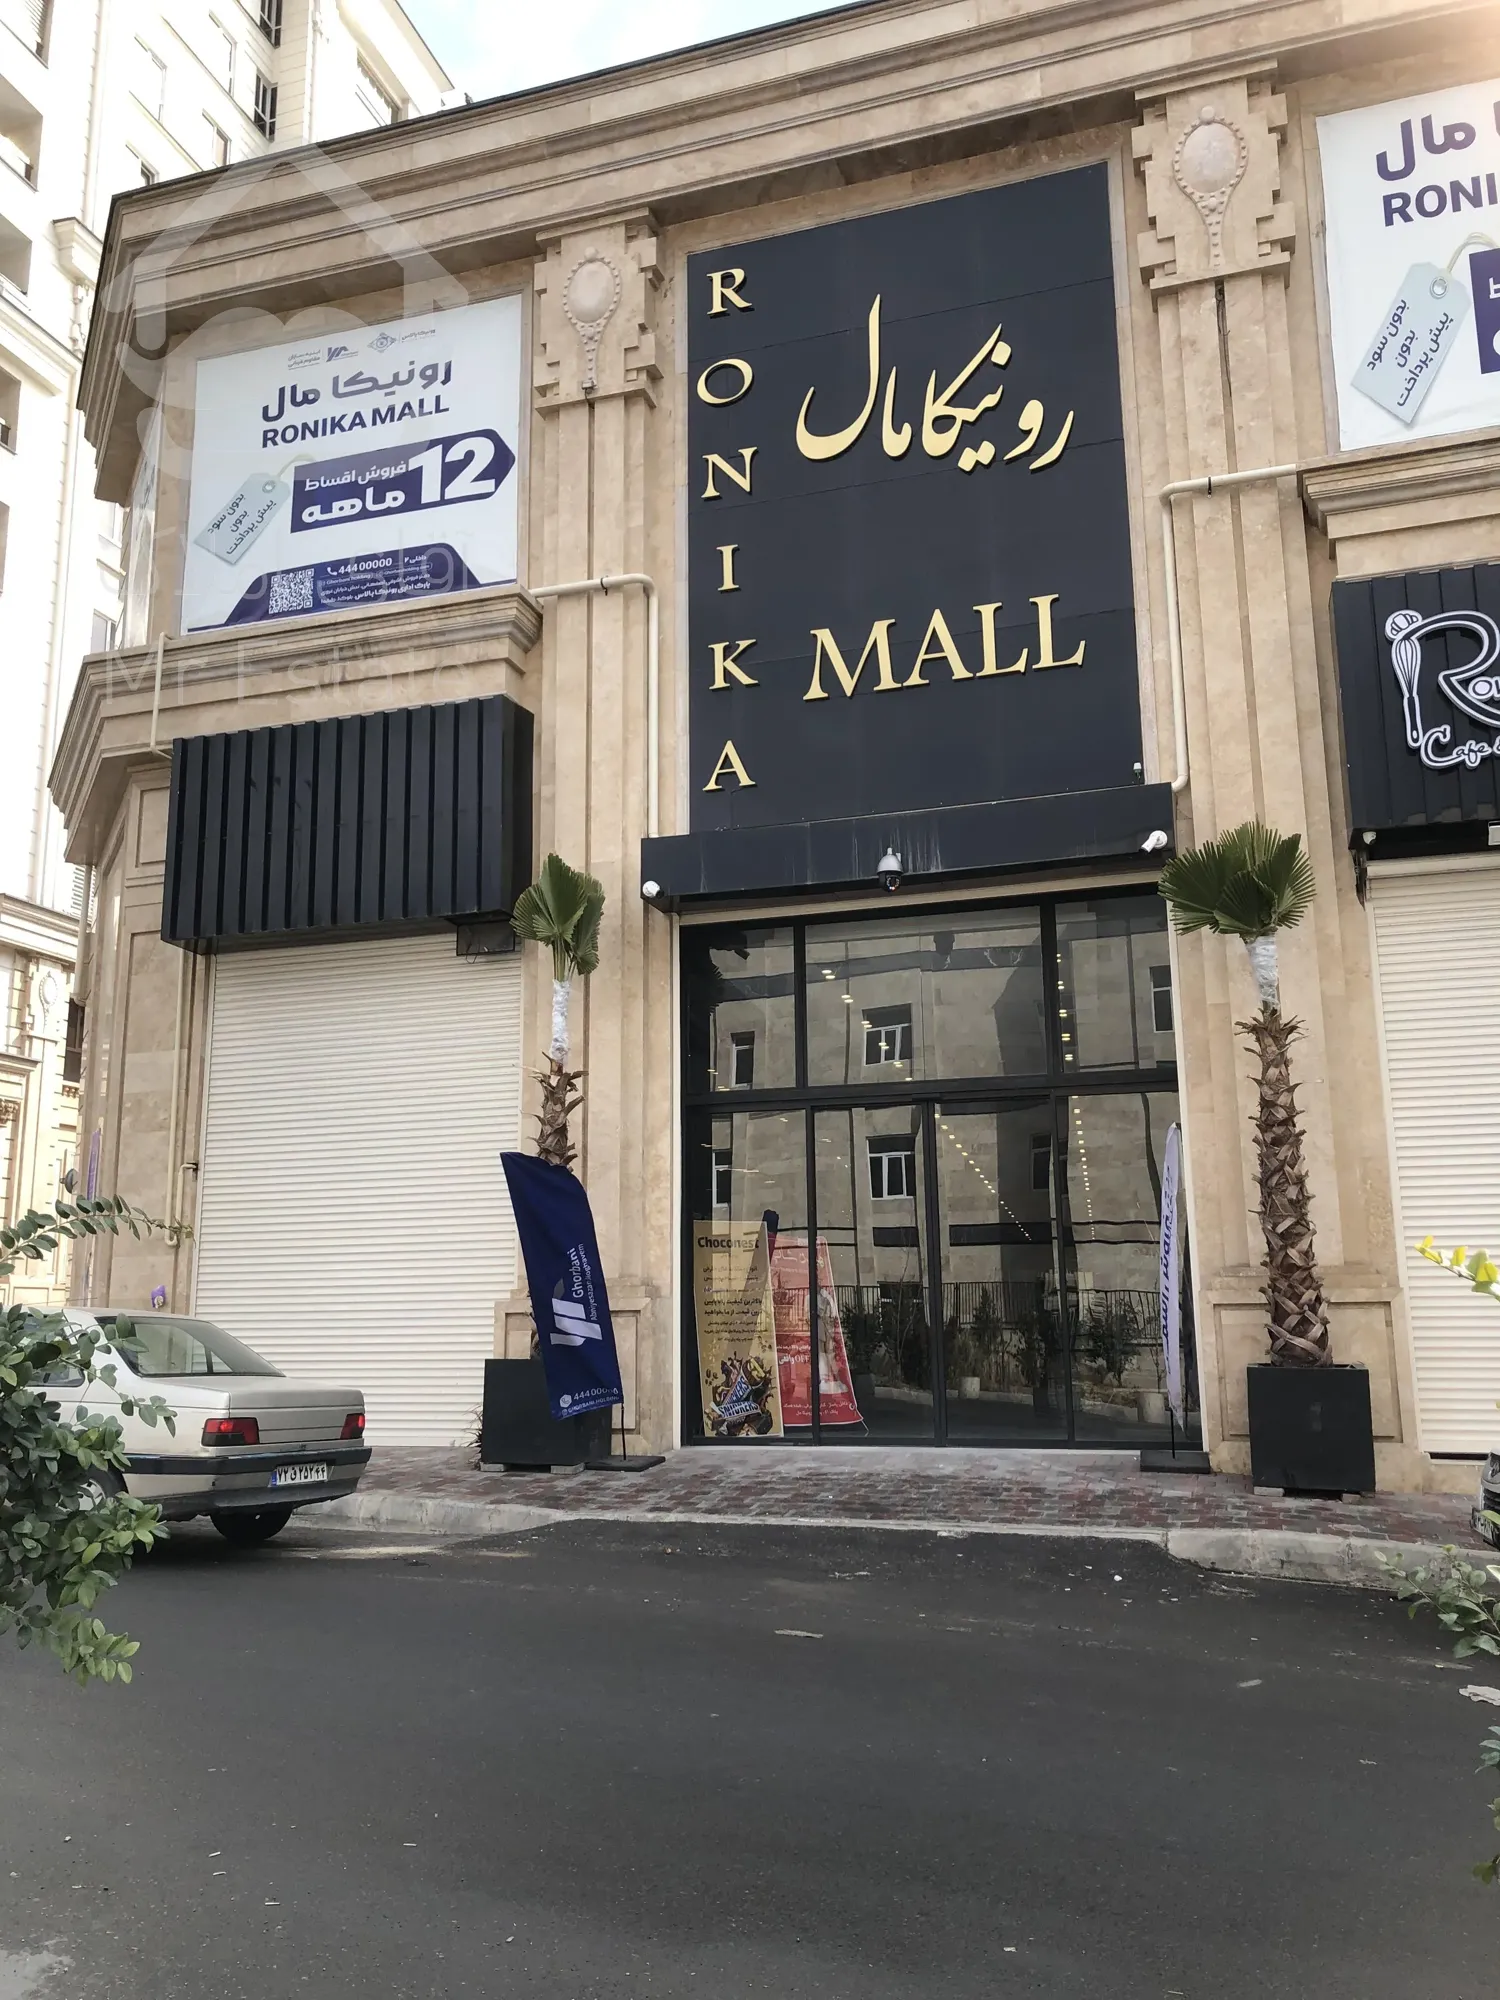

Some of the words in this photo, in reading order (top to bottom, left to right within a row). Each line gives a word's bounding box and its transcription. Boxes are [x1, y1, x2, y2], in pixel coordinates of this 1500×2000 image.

[1376, 114, 1476, 182] مال
[1387, 299, 1410, 338] بدون
[1429, 311, 1454, 354] پیش
[1366, 335, 1388, 371] سود
[1395, 329, 1417, 368] بدون
[332, 360, 452, 399] رونیکا
[795, 294, 912, 461] مال
[1397, 350, 1434, 407] پرداخت
[262, 384, 321, 423] مال
[918, 322, 1075, 473] رونیکا
[262, 410, 367, 448] RONIKA
[371, 394, 450, 427] MALL
[304, 469, 356, 491] اقساط
[358, 461, 407, 485] فروش
[408, 436, 496, 504] 12
[207, 514, 227, 534] سود
[227, 493, 246, 516] بدون
[230, 510, 250, 533] بدون
[256, 499, 277, 524] پیش
[302, 486, 406, 523] ماهه
[226, 522, 259, 555] پرداخت
[802, 593, 1087, 701] MALL
[1420, 724, 1493, 769] Cafe
[697, 1236, 760, 1249] Choconest
[566, 1247, 584, 1299] Ghorbani
[573, 1387, 619, 1401] 4440000
